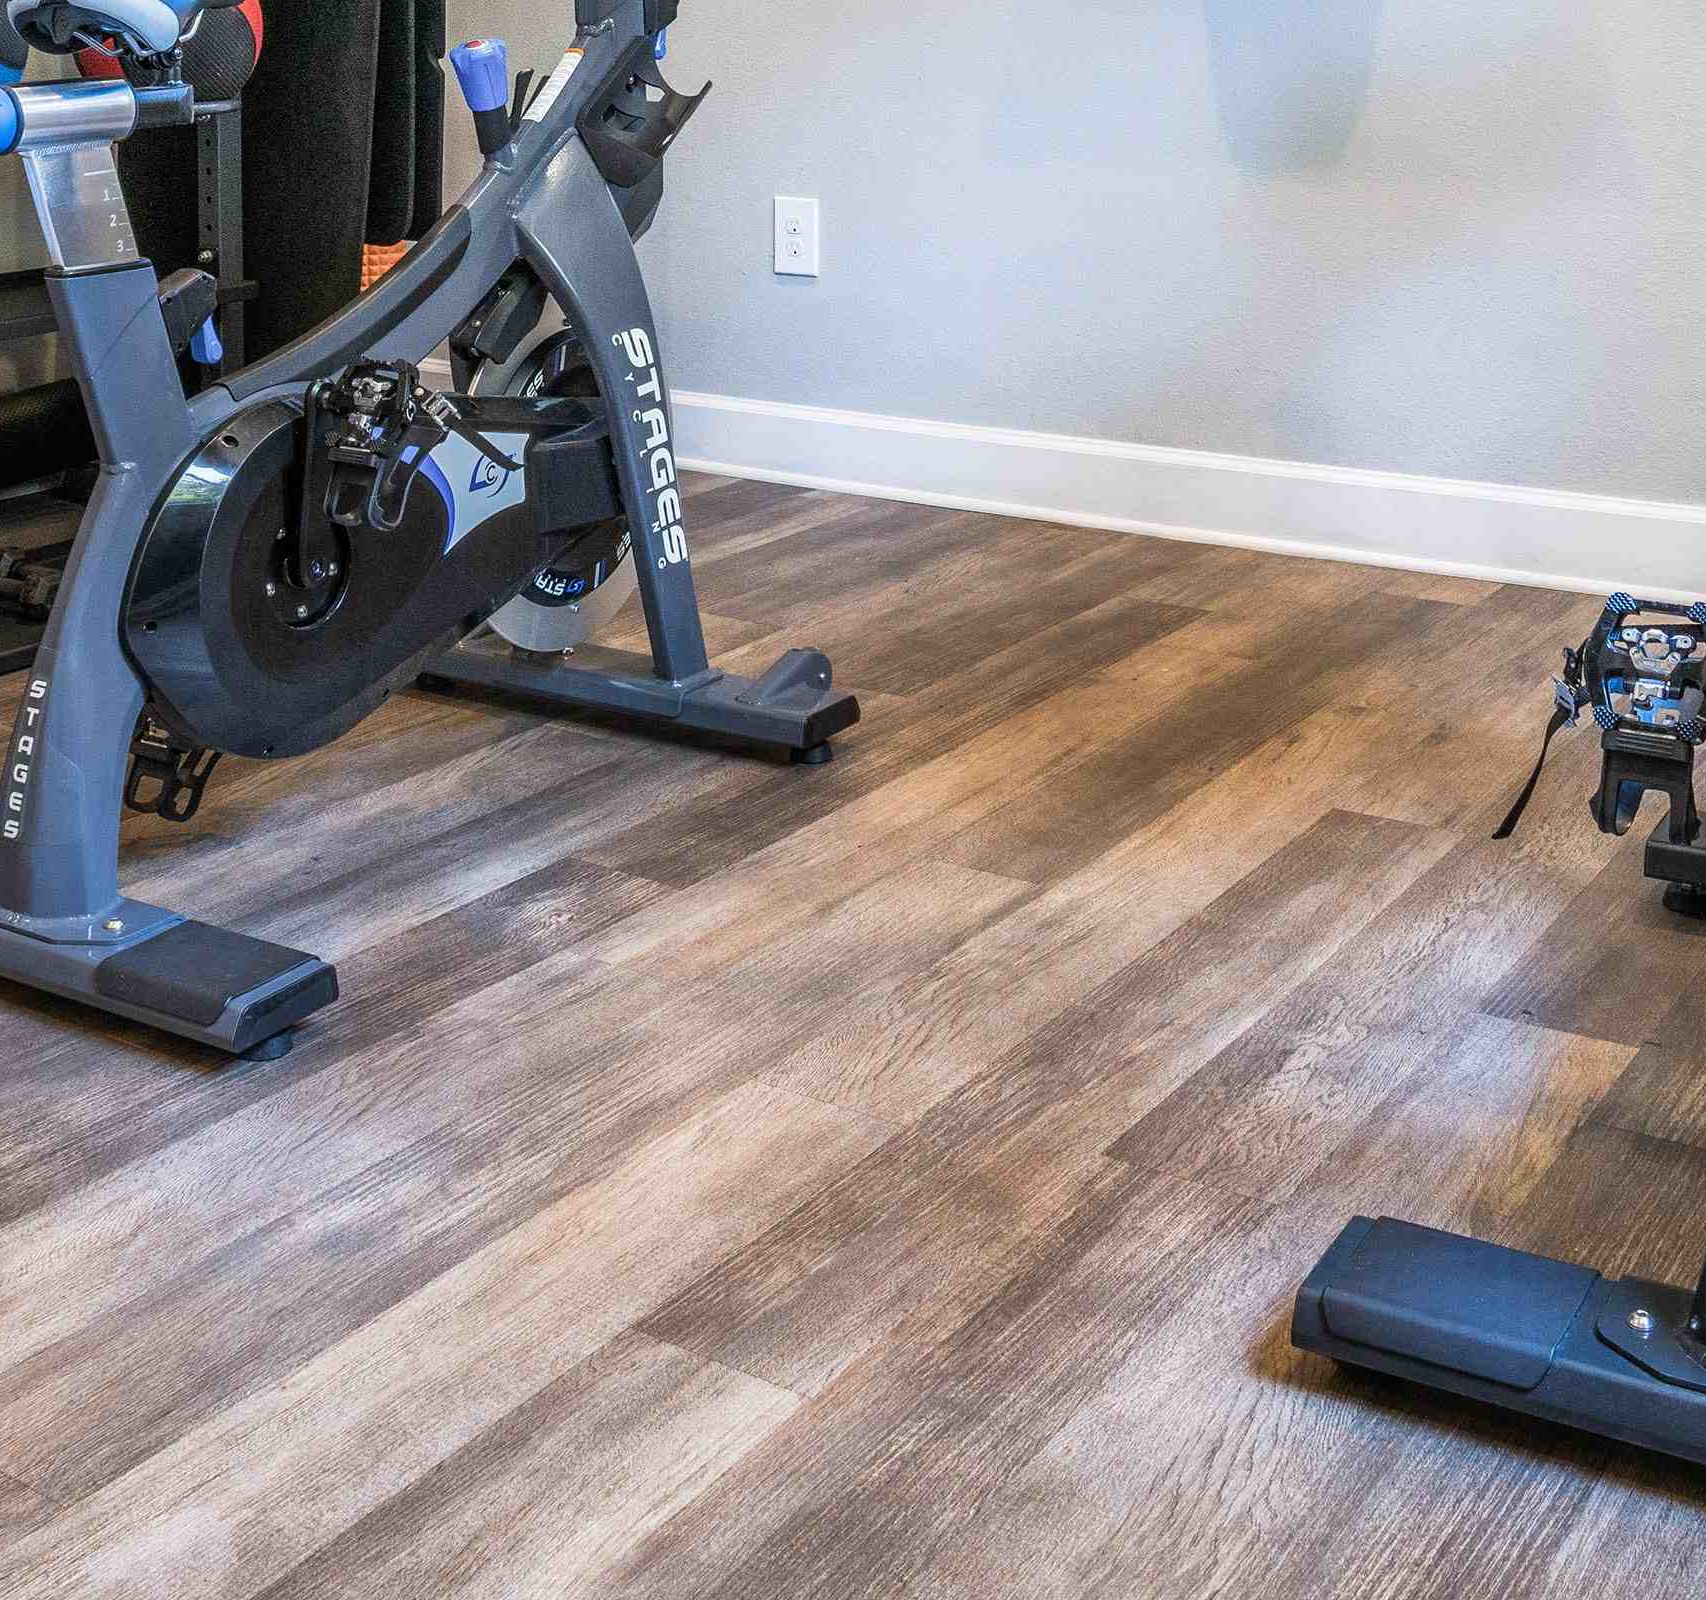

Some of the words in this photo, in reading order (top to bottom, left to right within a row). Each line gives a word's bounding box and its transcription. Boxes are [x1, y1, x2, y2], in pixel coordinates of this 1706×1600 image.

[102, 188, 110, 202] 1
[109, 213, 117, 228] 2
[116, 239, 124, 253] 3
[621, 326, 691, 565] STAGES
[2, 678, 48, 840] STAGES
